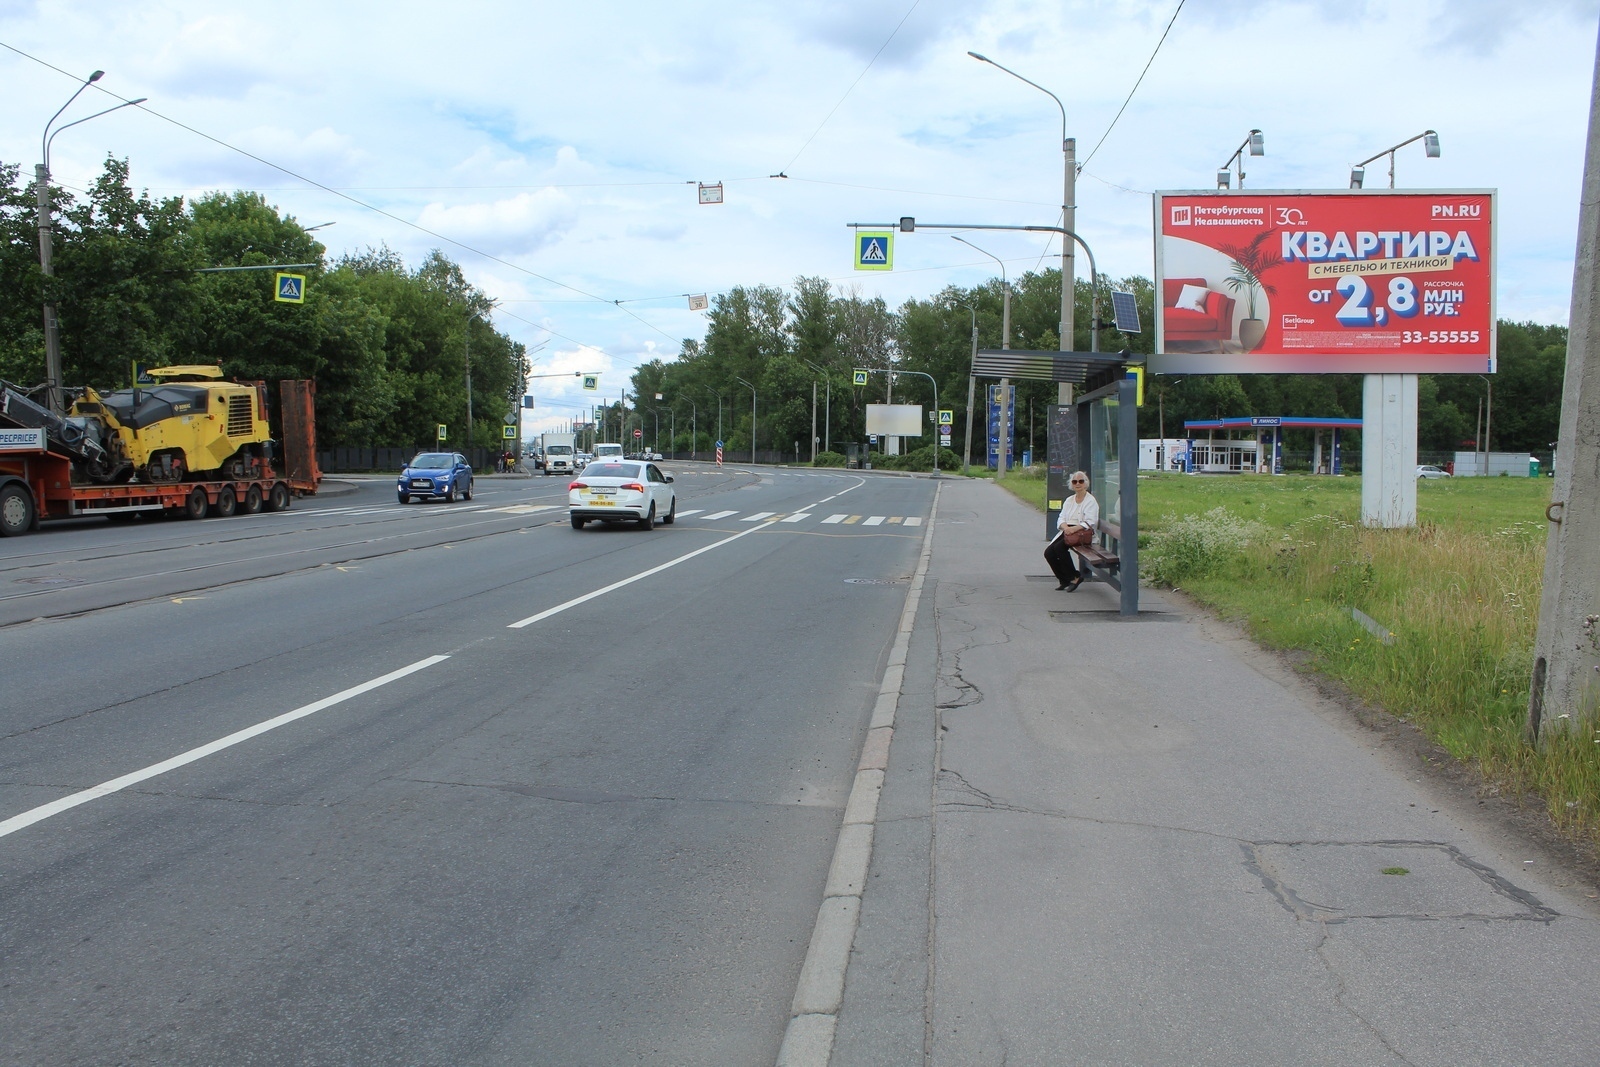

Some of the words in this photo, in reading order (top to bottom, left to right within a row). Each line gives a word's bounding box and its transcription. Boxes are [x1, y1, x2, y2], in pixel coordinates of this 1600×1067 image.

[1173, 207, 1190, 224] ПН
[1194, 205, 1264, 216] Петербургская
[1276, 207, 1304, 226] 30
[1431, 204, 1481, 218] PN.RU
[1194, 217, 1264, 226] Недвижимость
[1281, 230, 1478, 262] КВАРТИРА
[1314, 265, 1322, 275] С
[1323, 261, 1377, 275] МЕБЕЛЬЮ
[1379, 261, 1388, 271] И
[1390, 256, 1448, 271] ТЕХНИКОЙ
[1308, 289, 1332, 304] ОТ
[1336, 275, 1417, 323] 2,8
[1424, 289, 1464, 303] МЛН
[1402, 330, 1480, 344] 33-55555
